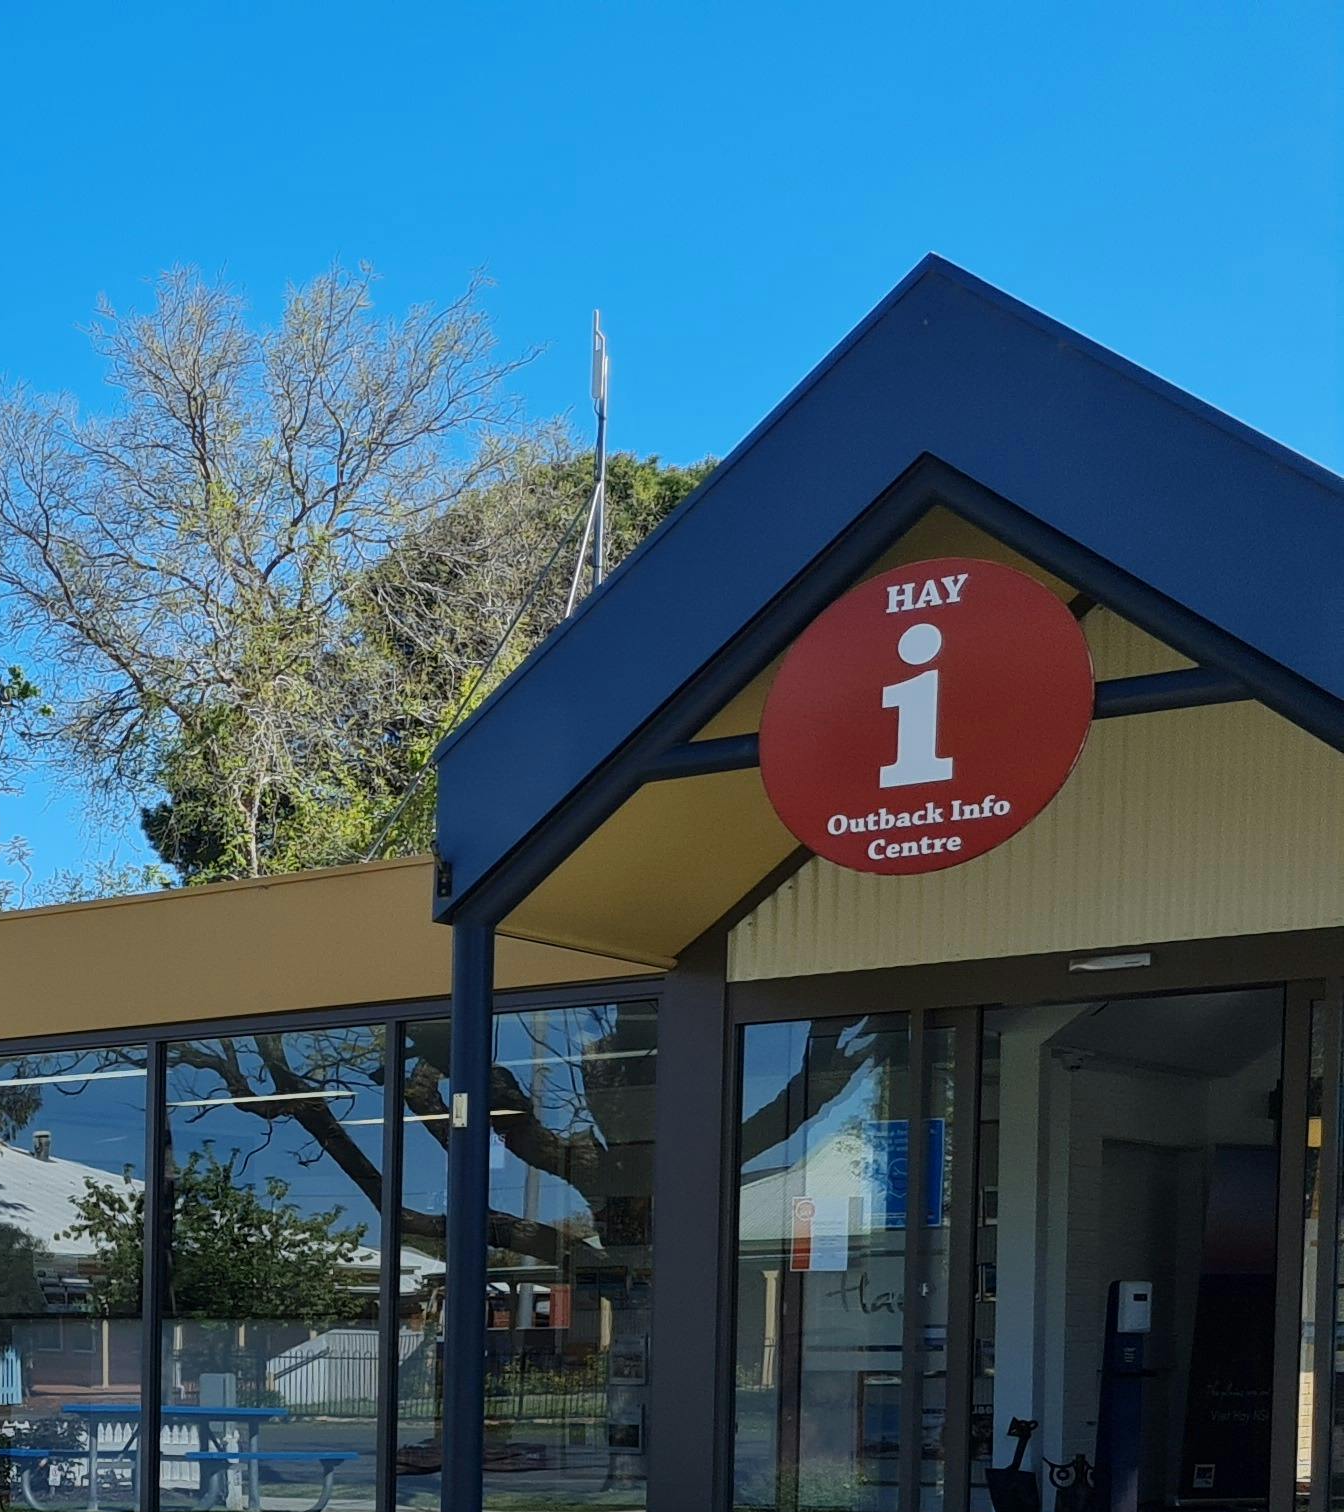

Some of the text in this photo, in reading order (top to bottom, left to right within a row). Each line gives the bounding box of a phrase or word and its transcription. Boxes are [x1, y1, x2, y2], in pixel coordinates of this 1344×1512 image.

[884, 572, 969, 614] HAY
[826, 795, 1011, 836] Outback Info
[866, 834, 963, 861] Centre
